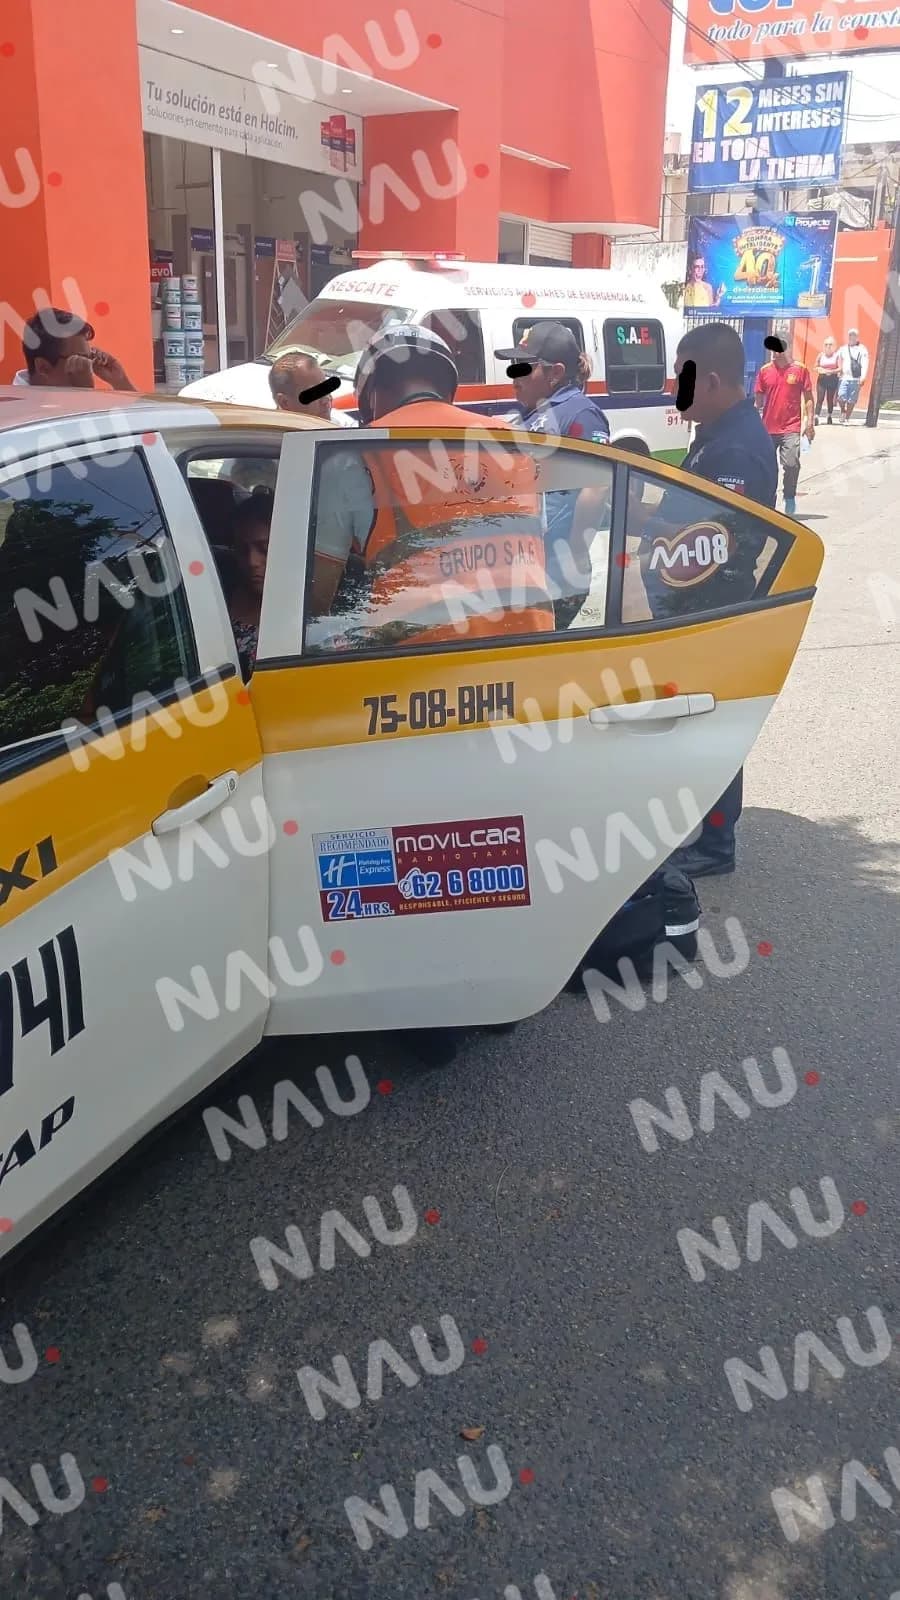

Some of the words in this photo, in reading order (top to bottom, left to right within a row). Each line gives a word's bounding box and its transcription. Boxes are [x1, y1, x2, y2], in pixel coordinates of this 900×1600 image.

[708, 19, 751, 42] todo
[753, 16, 807, 44] para
[812, 12, 832, 34] la
[839, 8, 900, 31] const
[758, 84, 812, 108] MESES
[815, 81, 844, 103] SIN
[146, 81, 162, 101] Tu
[166, 89, 216, 116] solución
[218, 106, 242, 123] está
[244, 113, 257, 128] en
[261, 114, 299, 140] Holcim.
[147, 105, 184, 123] Soluciones
[696, 87, 754, 139] 12
[756, 107, 842, 133] INTERESES
[692, 141, 715, 163] EN
[720, 136, 770, 162] TODA
[739, 159, 761, 182] LA
[766, 153, 836, 180] TIENDA
[329, 280, 399, 297] RESCATE
[440, 542, 496, 577] GRUPO
[649, 533, 729, 569] M-08
[363, 681, 515, 736] 75-08-BHH
[320, 836, 389, 852] RECOMENDADO
[330, 831, 375, 840] SERVICIO
[360, 866, 392, 876] Express
[411, 871, 442, 898] 62
[447, 869, 464, 896] 6
[467, 864, 525, 894] 8000
[454, 896, 490, 905] EFICIENTE
[0, 1095, 75, 1187] AP
